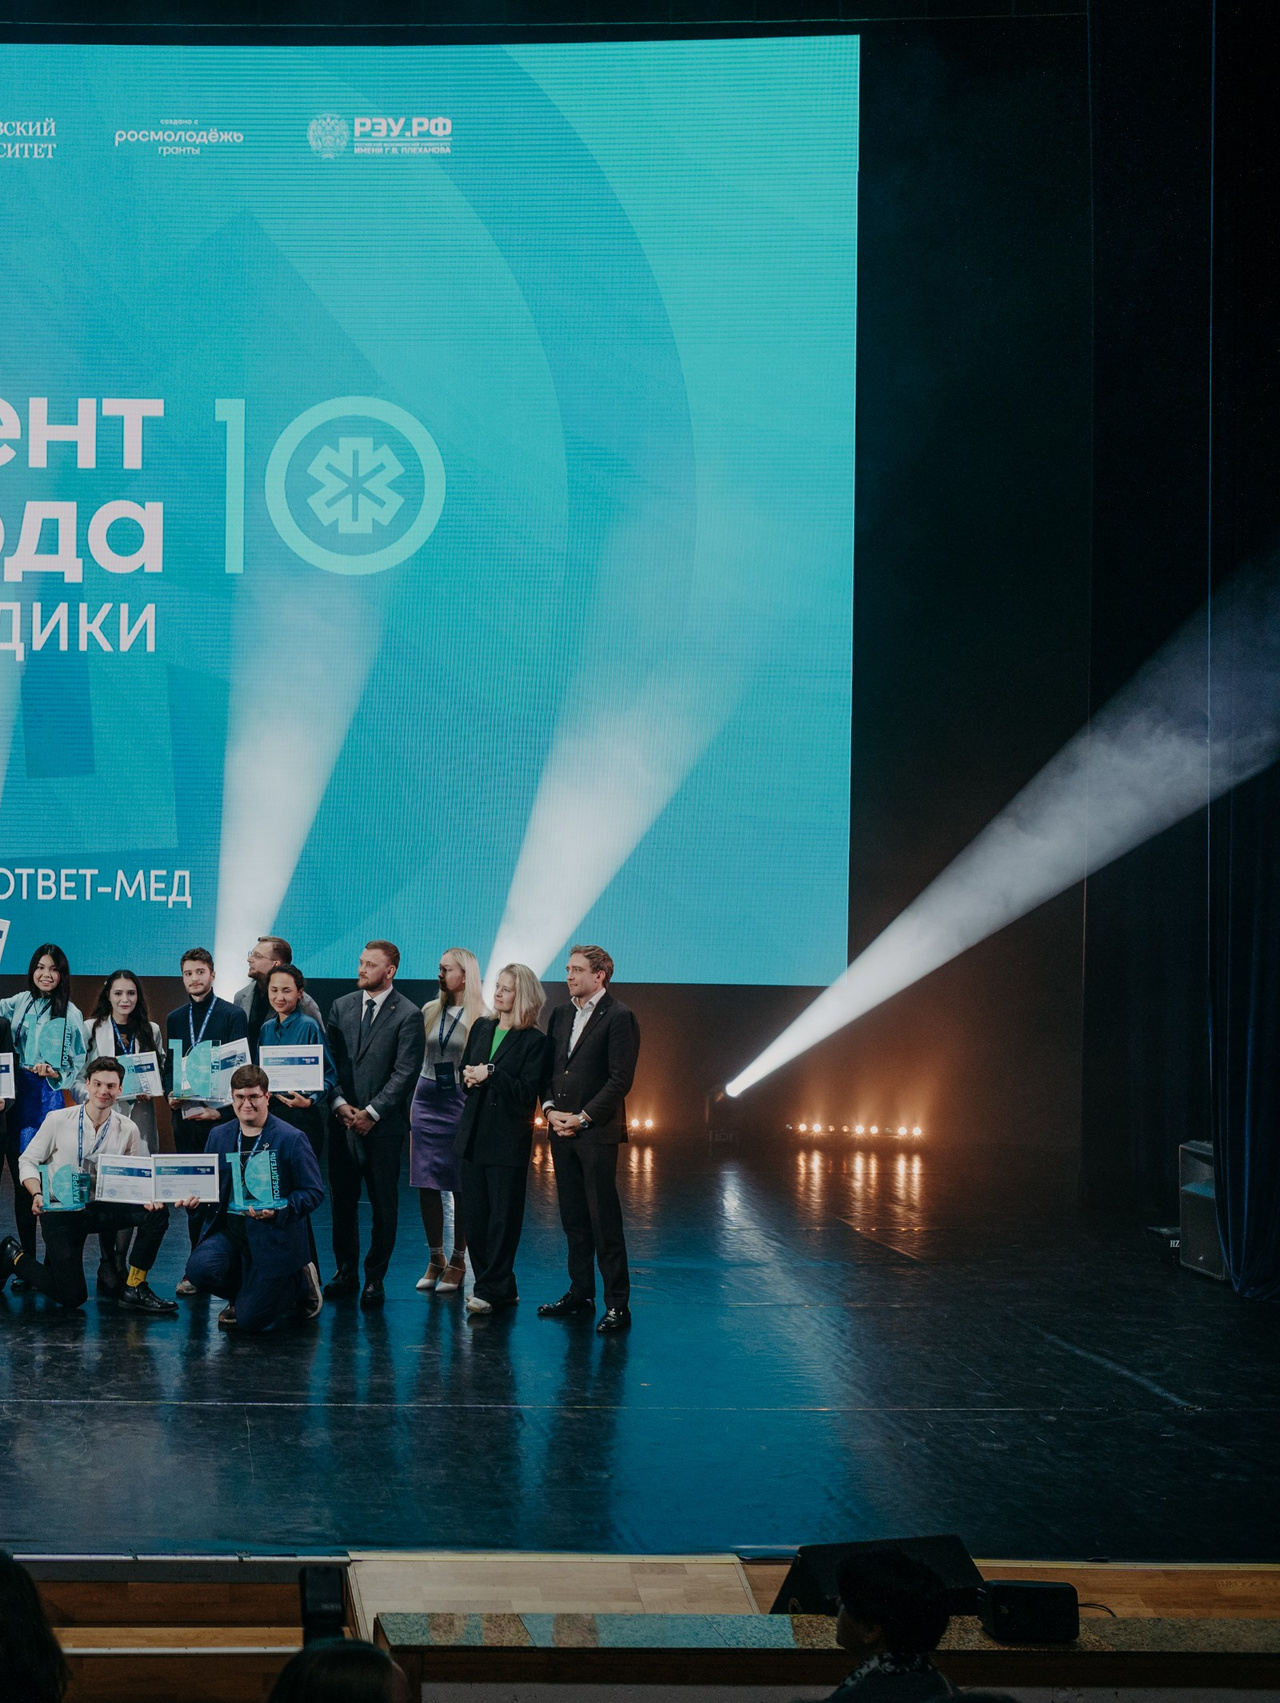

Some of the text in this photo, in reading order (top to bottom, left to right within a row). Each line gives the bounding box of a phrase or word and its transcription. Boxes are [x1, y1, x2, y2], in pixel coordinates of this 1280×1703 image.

[354, 116, 452, 137] РЭУ.РФ
[115, 128, 244, 147] росмолодёжь
[158, 146, 200, 157] гранты
[269, 1152, 280, 1200] ПОБЕДИТЕЛЬ
